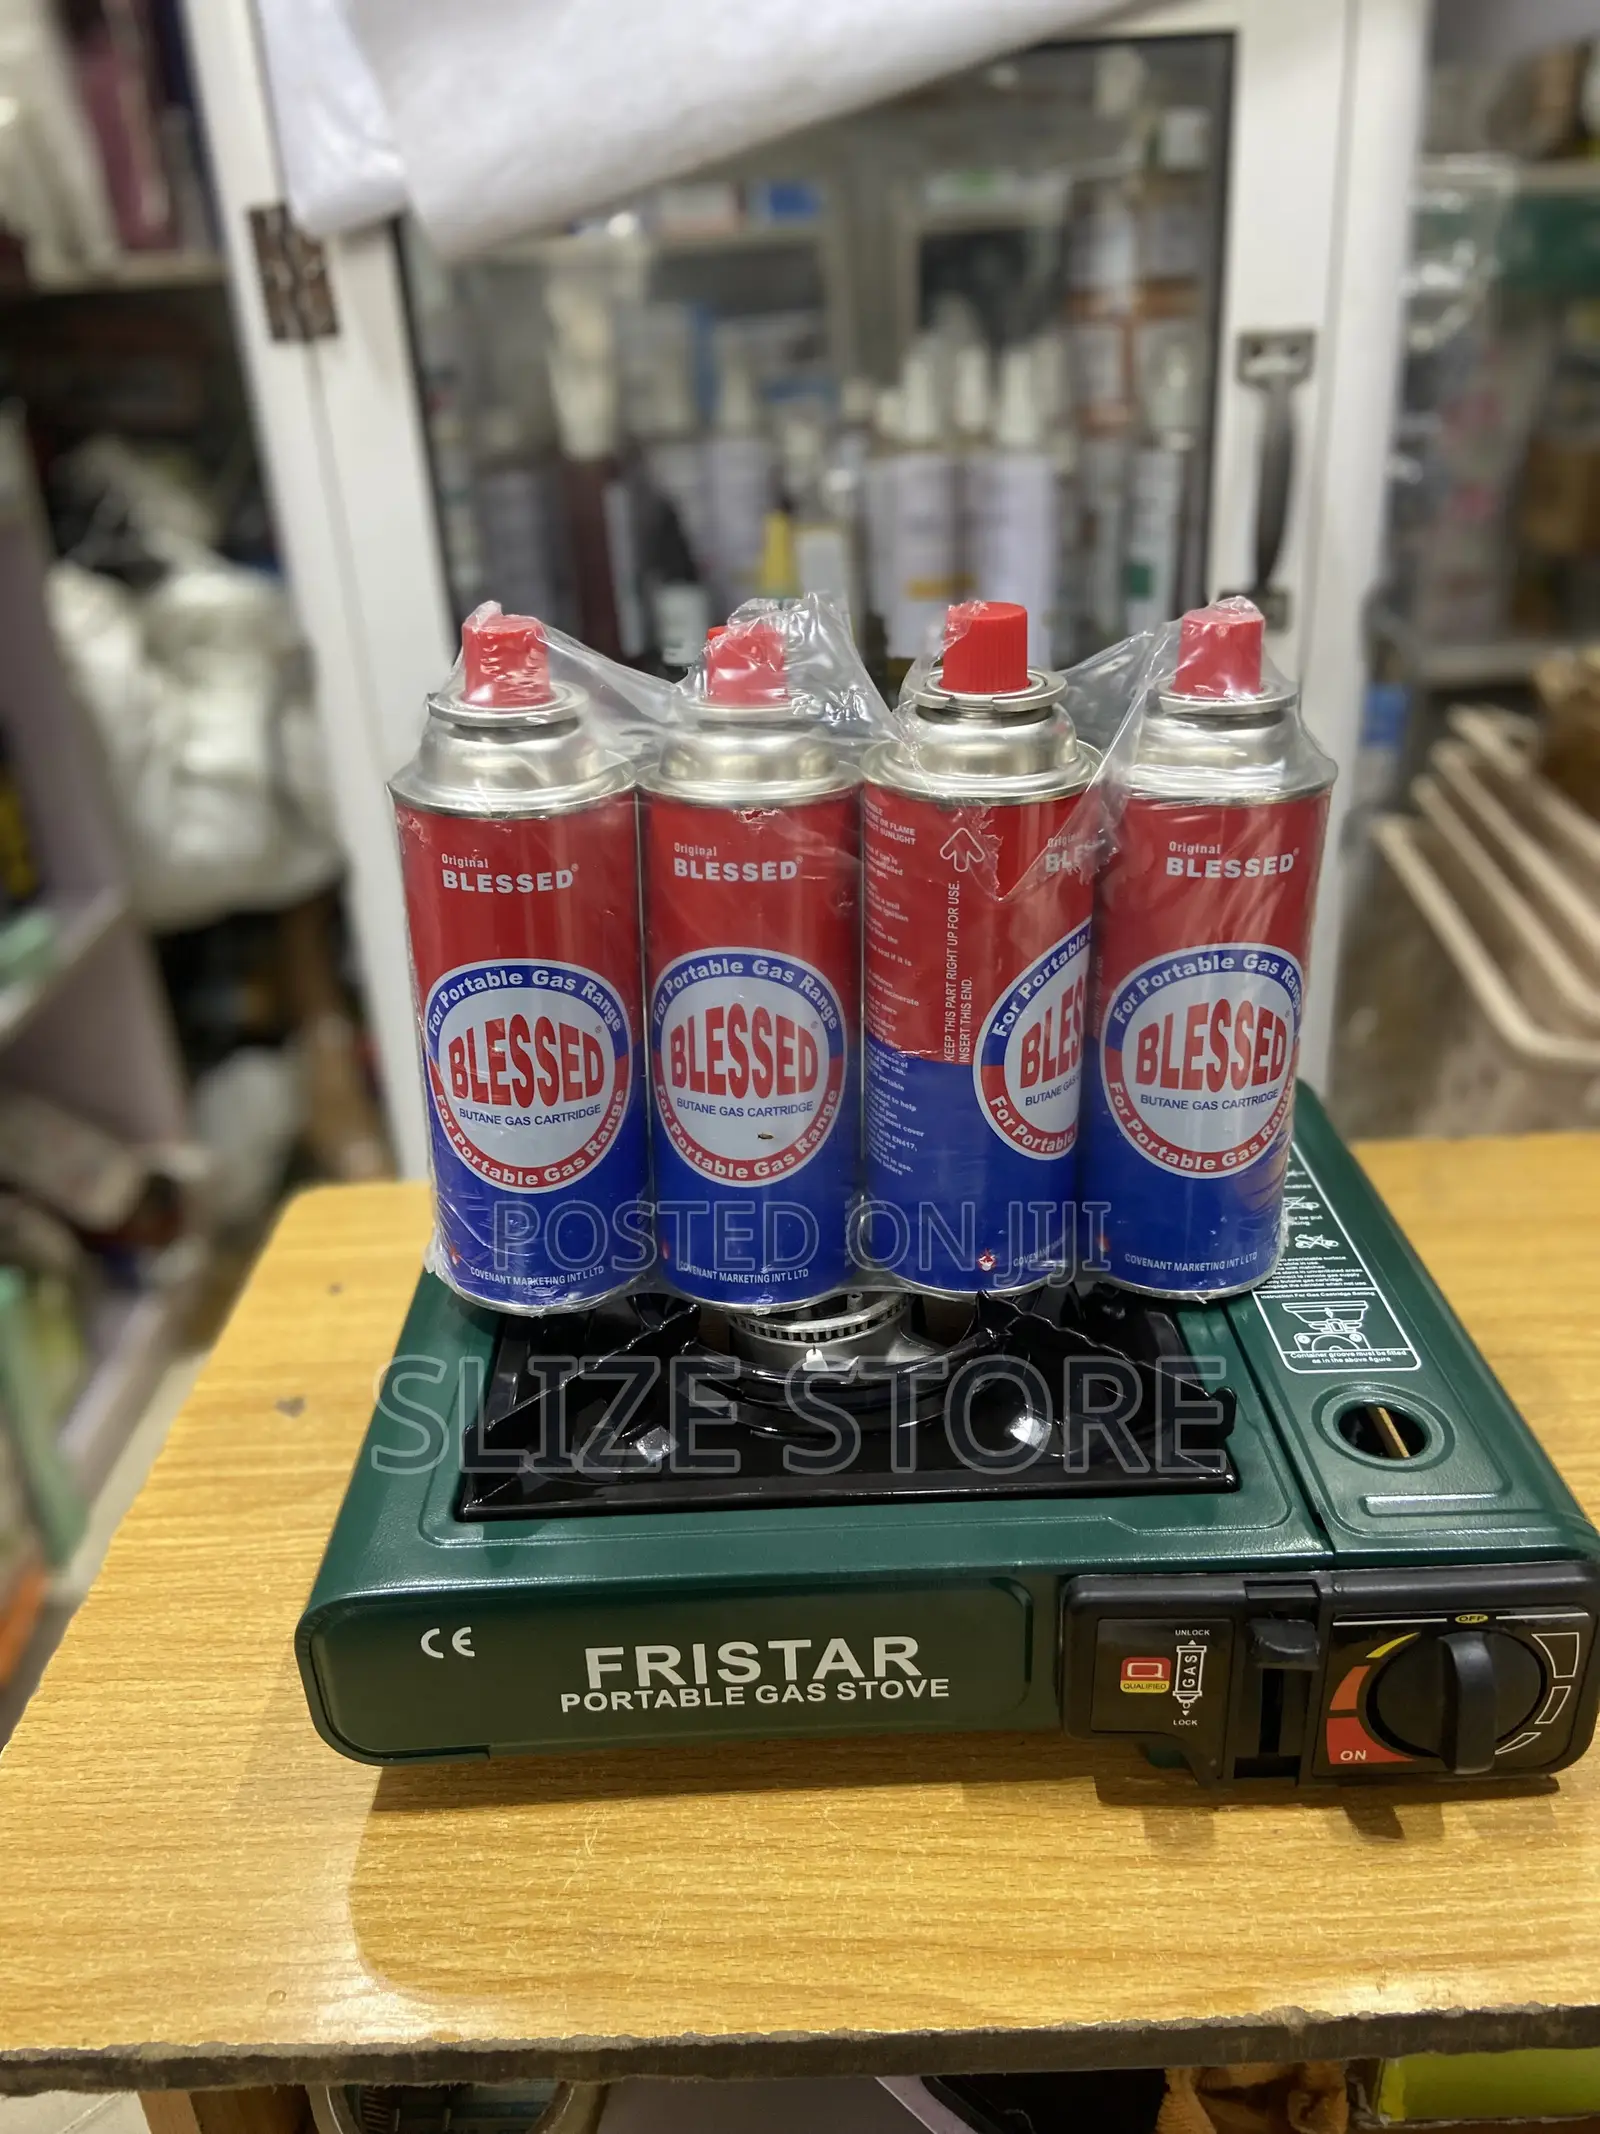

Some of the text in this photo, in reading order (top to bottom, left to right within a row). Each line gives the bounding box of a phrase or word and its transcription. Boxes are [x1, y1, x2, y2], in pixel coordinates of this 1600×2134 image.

[880, 827, 917, 845] SUNLIGHT
[890, 822, 916, 836] FLAME
[441, 853, 489, 868] Original
[674, 842, 717, 857] Original
[1169, 841, 1220, 855] Original
[674, 858, 797, 881] BLESSED
[1166, 853, 1294, 878] BLESSED
[442, 869, 573, 893] BLESSED
[944, 881, 960, 1062] KEEP THIS PART RIGHT UP FOR USE.
[992, 934, 1087, 1037] For Portable
[428, 968, 621, 1036] For Portable Gas Range
[654, 996, 669, 1026] For
[664, 958, 743, 998] Portable
[752, 960, 794, 983] Gas
[799, 976, 837, 1030] Range
[1114, 992, 1138, 1025] For
[1136, 956, 1235, 994] Portable
[1243, 954, 1279, 975] Gas
[958, 977, 973, 1063] INSERT THIS END.
[1020, 974, 1087, 1089] BLES
[670, 1002, 818, 1099] BLESSED
[1135, 998, 1287, 1093] BLESSED
[448, 1014, 604, 1108] BLESSED
[677, 1099, 814, 1117] BUTANE GAS CARTRIDGE
[900, 1100, 917, 1112] help
[1026, 1087, 1062, 1106] BUTANE
[1141, 1089, 1279, 1111] BUTANE GAS CARTRIDGE
[459, 1105, 601, 1126] BUTANE GAS CARTRIDGE
[990, 1095, 1074, 1153] For Portable
[1110, 1082, 1130, 1117] For
[1128, 1120, 1216, 1170] Portable
[1222, 1142, 1260, 1166] Gas
[437, 1090, 624, 1186] For Portable Gas Range
[658, 1085, 671, 1122] For
[670, 1124, 748, 1179] Portable
[754, 1154, 795, 1177] Gas
[796, 1090, 837, 1153] Range
[903, 1126, 925, 1137] cover
[470, 1266, 511, 1284] COVENANT
[513, 1276, 565, 1286] MARKETING
[590, 1266, 605, 1277] LTD
[680, 1261, 718, 1281] COVENANT
[719, 1272, 770, 1284] MARKETING
[794, 1268, 809, 1280] LTD
[1124, 1253, 1173, 1270] COVENANT
[1174, 1260, 1225, 1272] MARKETING
[1246, 1252, 1258, 1264] LTD
[420, 1626, 476, 1659] CE
[584, 1635, 922, 1689] FRISTAR
[1182, 1655, 1198, 1688] GAS
[560, 1678, 949, 1713] PORTABLE GAS STOVE
[1340, 1750, 1368, 1762] ON
